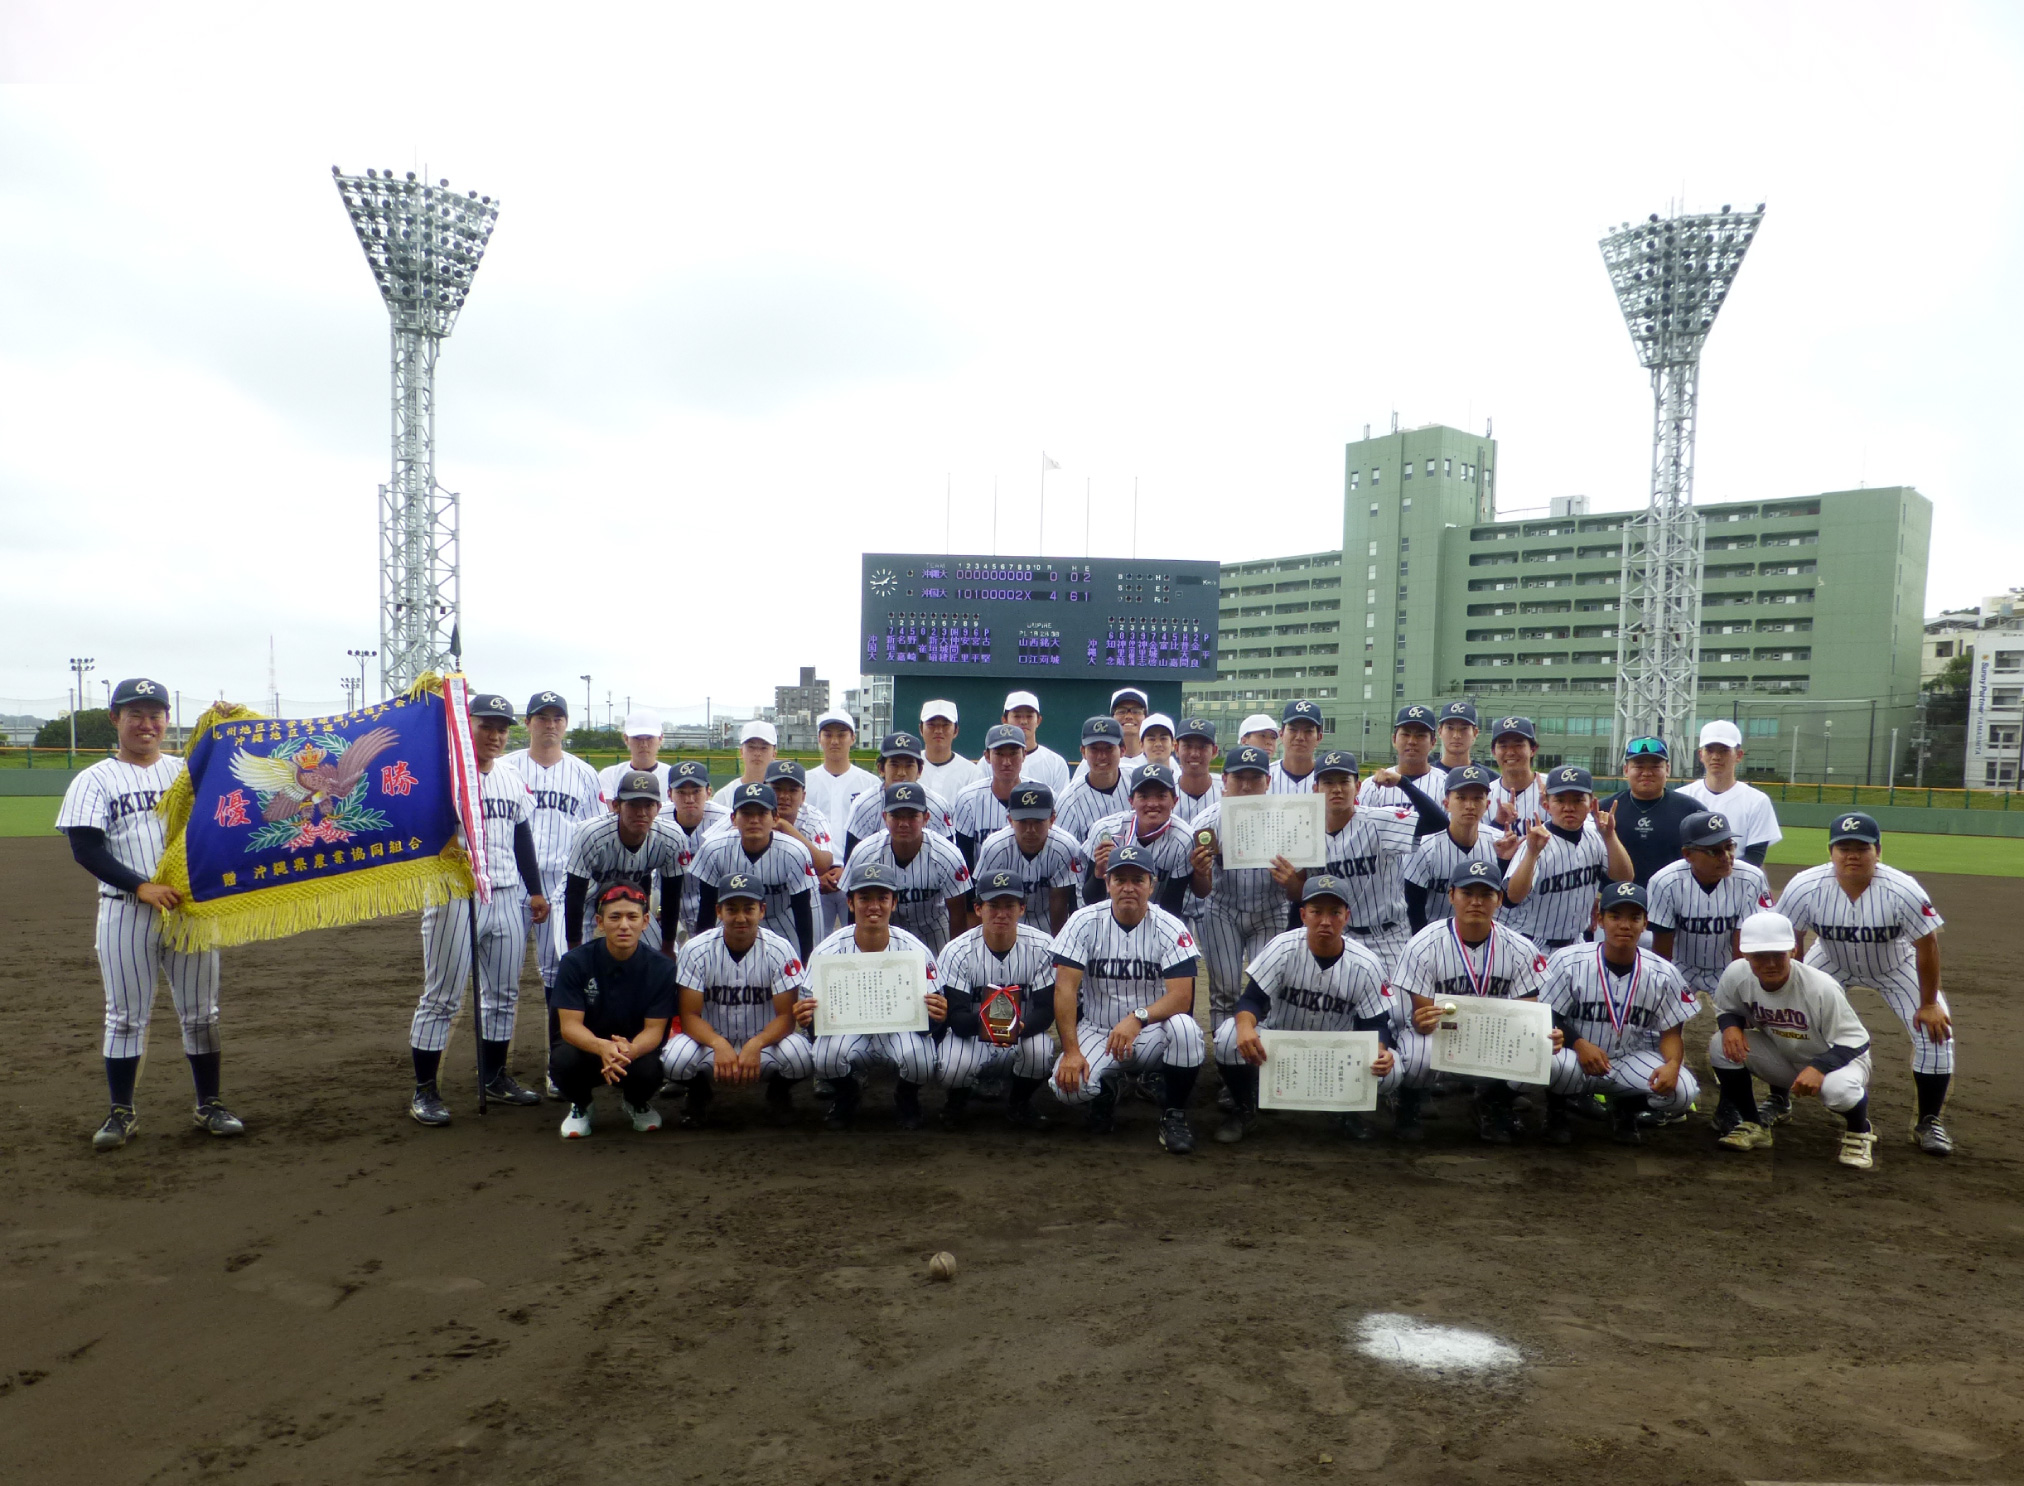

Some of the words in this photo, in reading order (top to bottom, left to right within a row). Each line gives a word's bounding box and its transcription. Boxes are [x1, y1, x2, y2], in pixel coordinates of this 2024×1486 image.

[1050, 572, 1057, 582] 0
[1071, 572, 1078, 582] 0
[1083, 572, 1091, 582] 2
[1050, 591, 1057, 601] 4
[1070, 591, 1078, 601] 6
[1130, 632, 1135, 640] 3
[1151, 632, 1156, 640] 7
[1162, 633, 1166, 641] 4
[1172, 633, 1177, 641] 5
[1183, 633, 1187, 641] H
[1194, 633, 1198, 641] 2
[1204, 634, 1208, 642] P
[1980, 662, 1989, 684] Sunny
[213, 788, 252, 828] 優
[381, 760, 419, 796] 勝
[1744, 1002, 1807, 1026] MISATO
[1770, 1028, 1811, 1041] TECHNICAL
